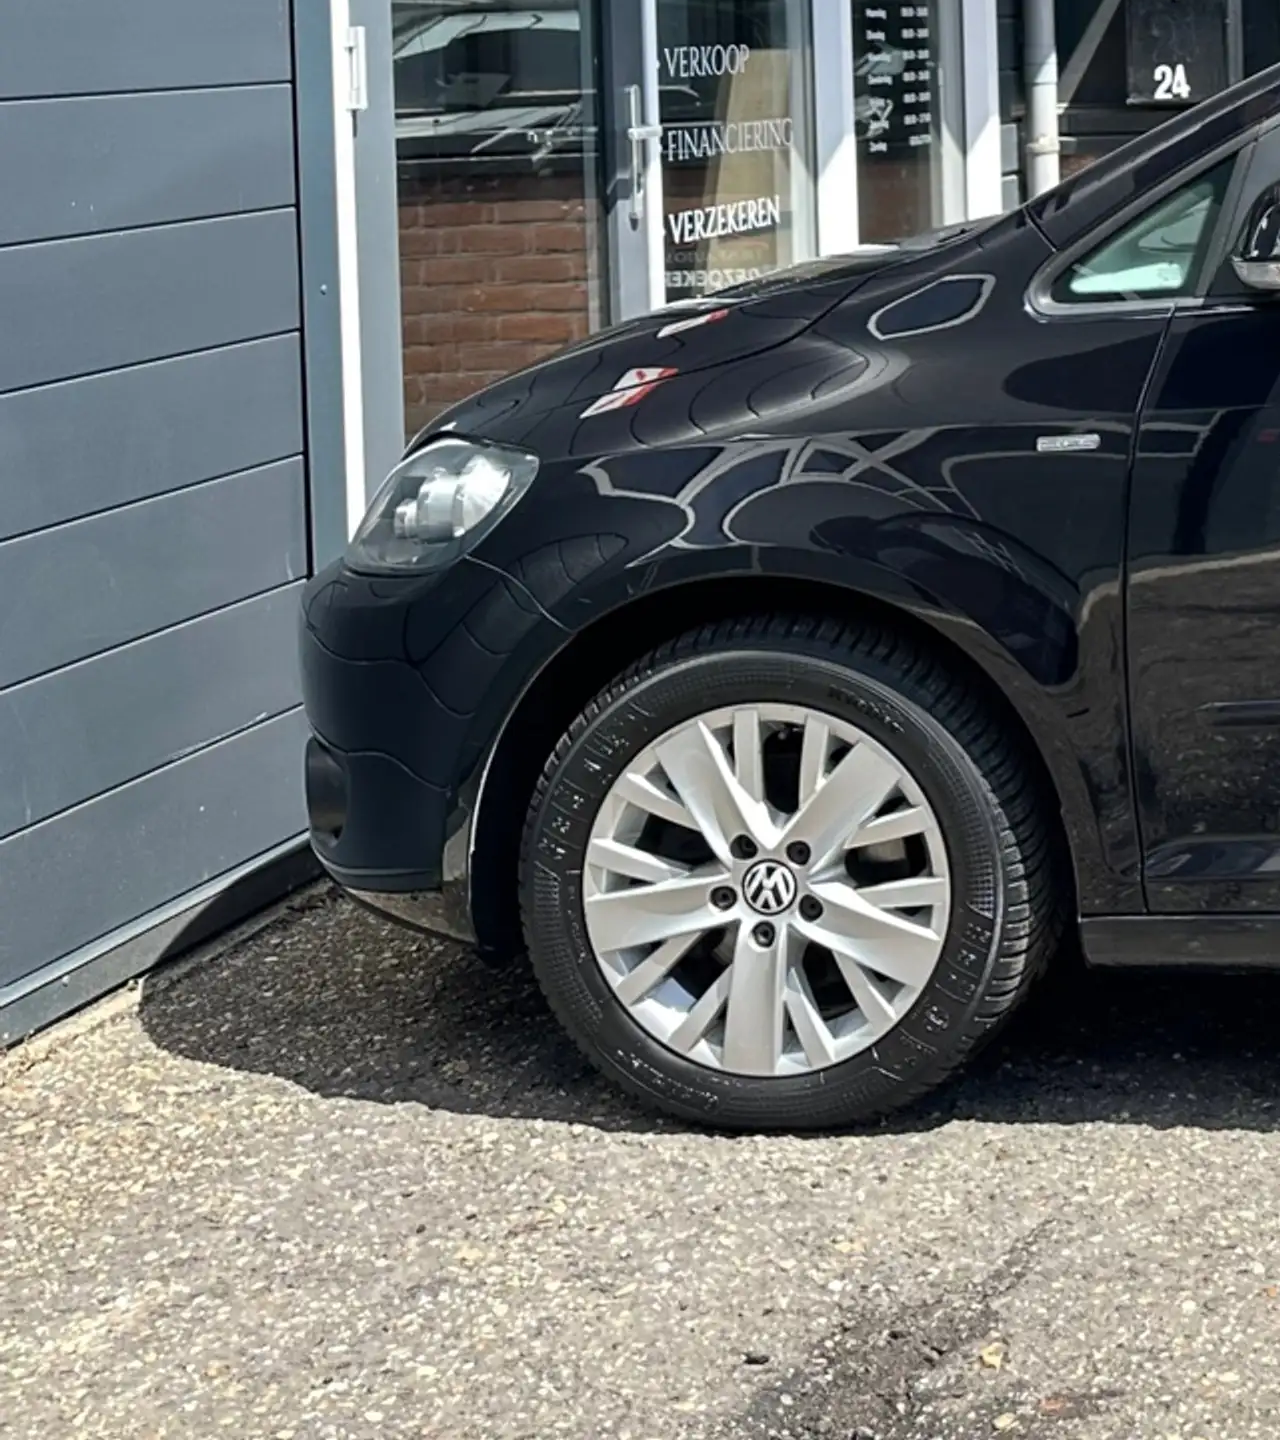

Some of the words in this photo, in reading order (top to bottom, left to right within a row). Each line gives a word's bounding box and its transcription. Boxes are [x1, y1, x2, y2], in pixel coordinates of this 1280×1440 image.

[664, 44, 750, 77] VERKOOP
[1153, 64, 1191, 99] 24
[667, 118, 793, 162] FINANCIERING
[668, 194, 781, 244] VERZEKEREN
